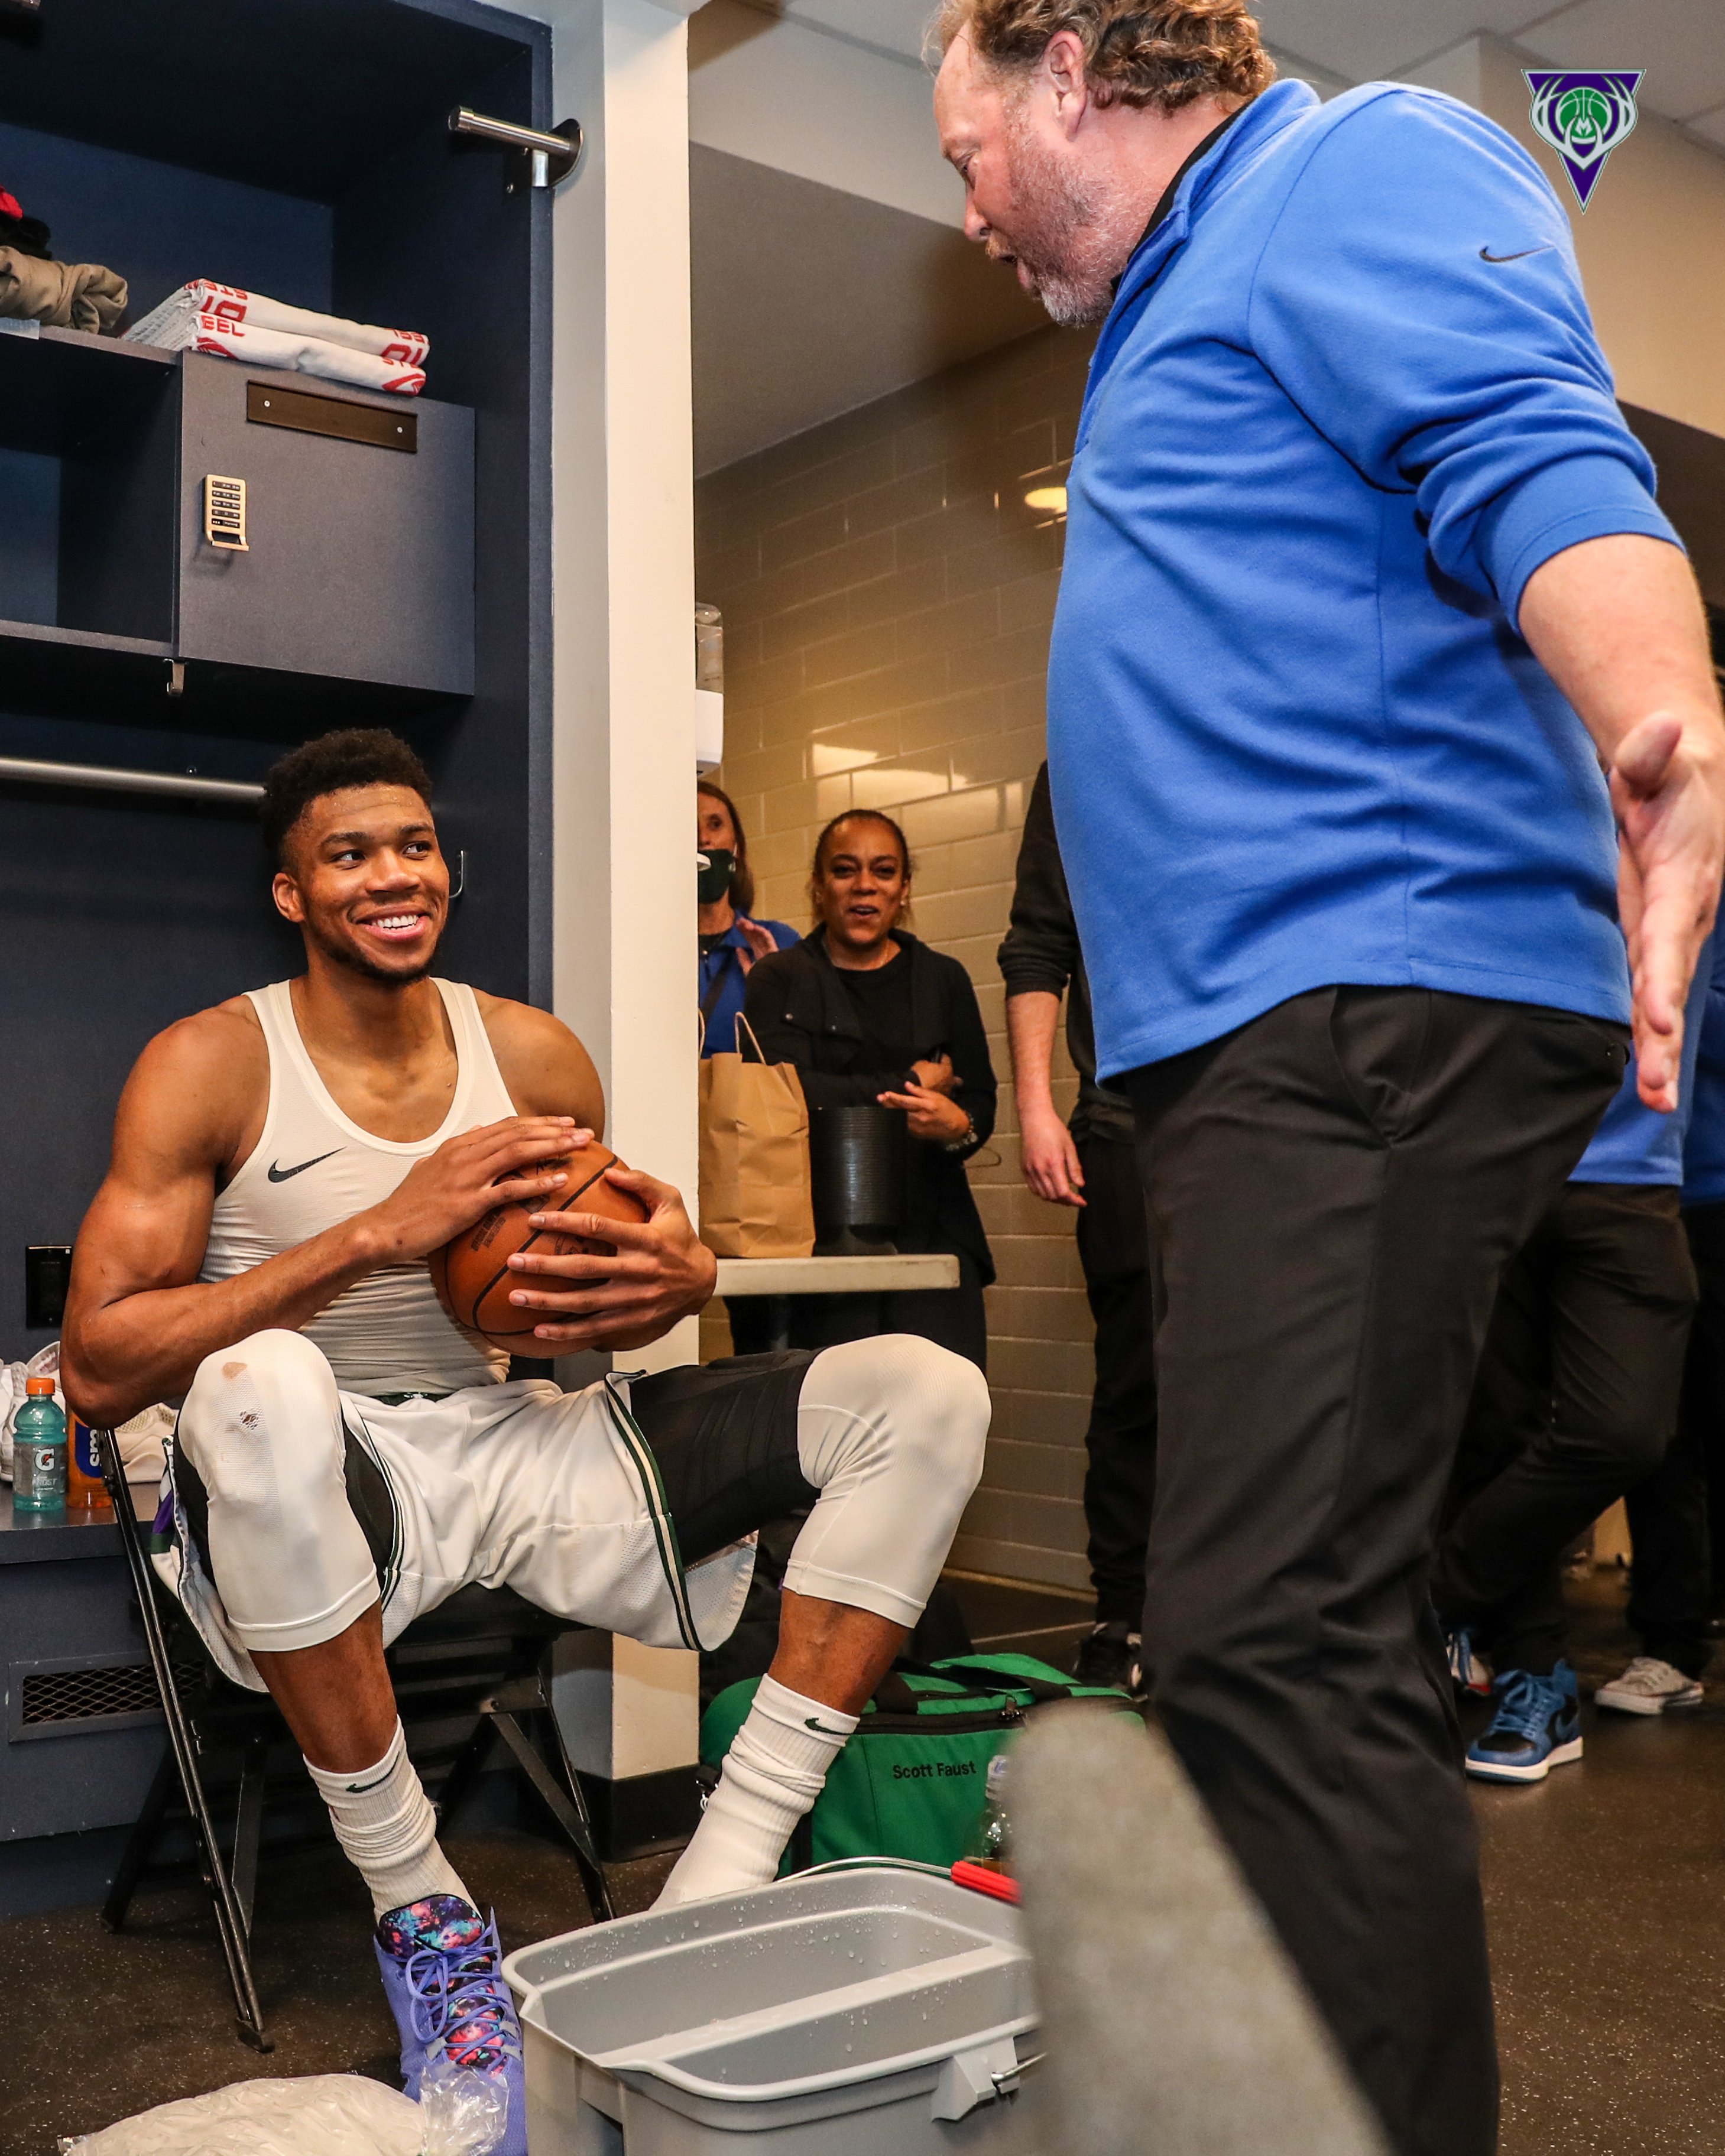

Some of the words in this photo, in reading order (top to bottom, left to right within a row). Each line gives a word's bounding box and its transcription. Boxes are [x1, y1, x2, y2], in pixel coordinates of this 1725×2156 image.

[201, 315, 245, 337] EEL
[35, 1448, 54, 1471] G
[893, 1764, 933, 1779] Scott
[936, 1761, 977, 1777] Faust
